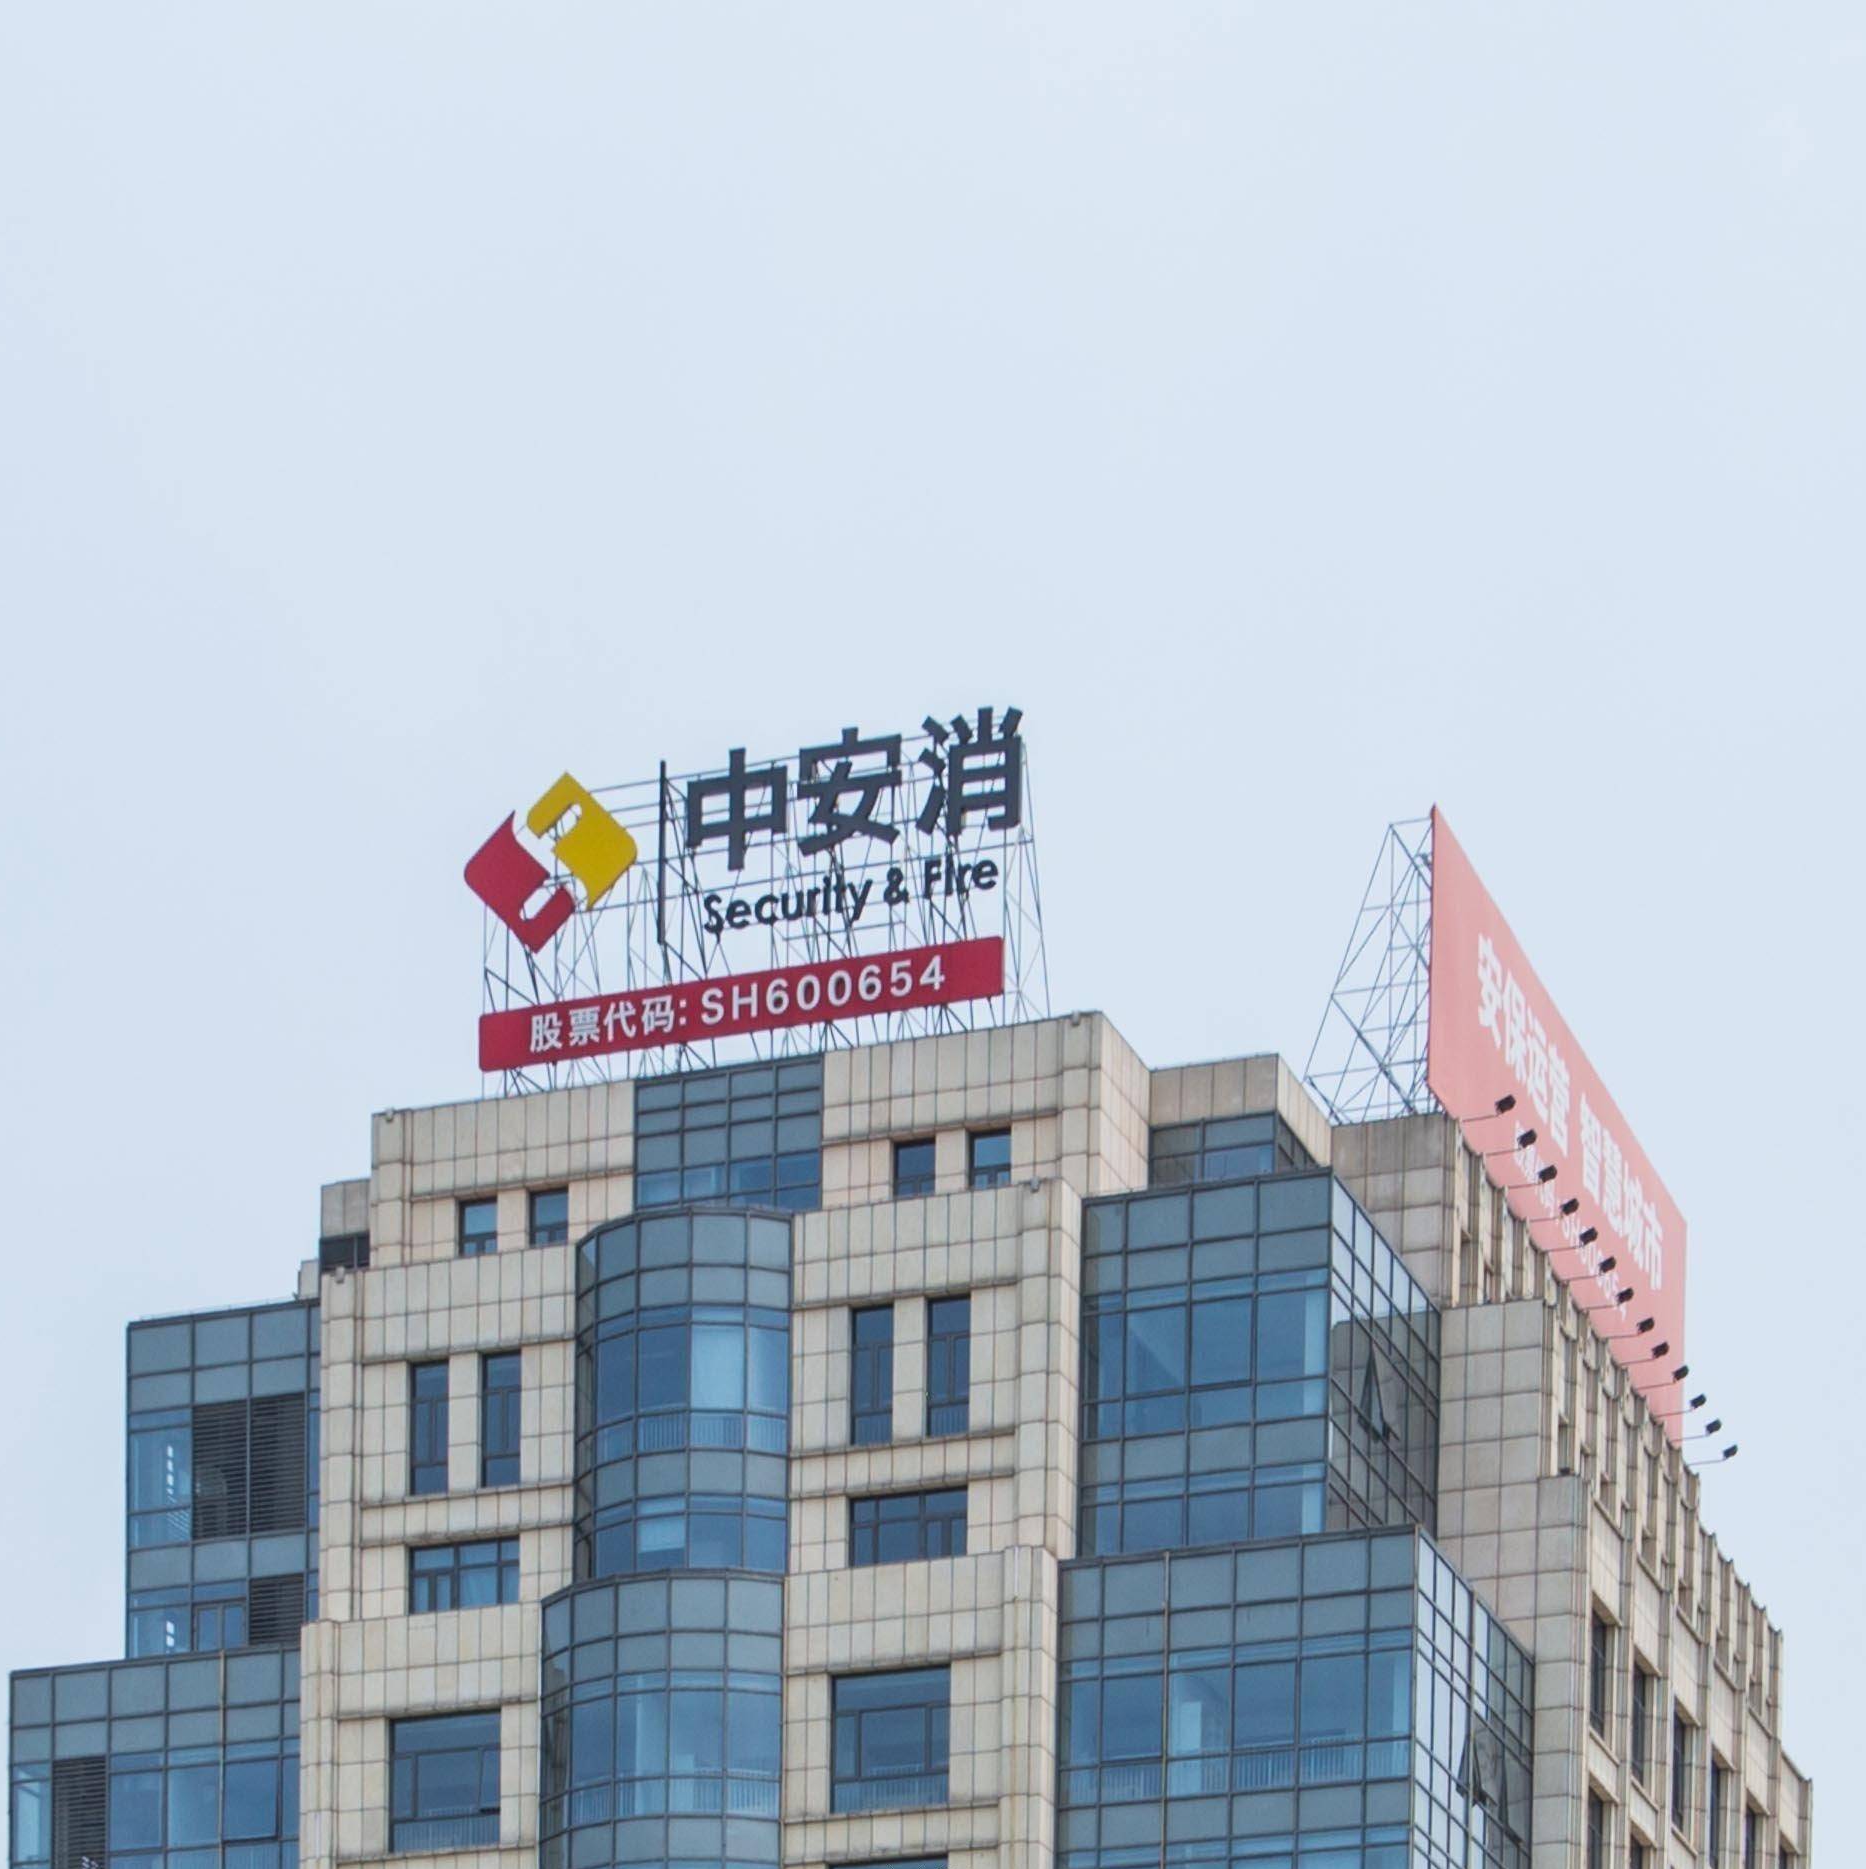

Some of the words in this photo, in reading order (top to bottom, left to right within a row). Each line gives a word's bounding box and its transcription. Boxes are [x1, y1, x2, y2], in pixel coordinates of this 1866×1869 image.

[687, 706, 1024, 871] 中安消
[703, 865, 874, 934] Security
[884, 867, 910, 906] &
[923, 851, 999, 901] Fire
[1477, 933, 1570, 1158] 安保运营
[1579, 1091, 1664, 1291] 智慧城市
